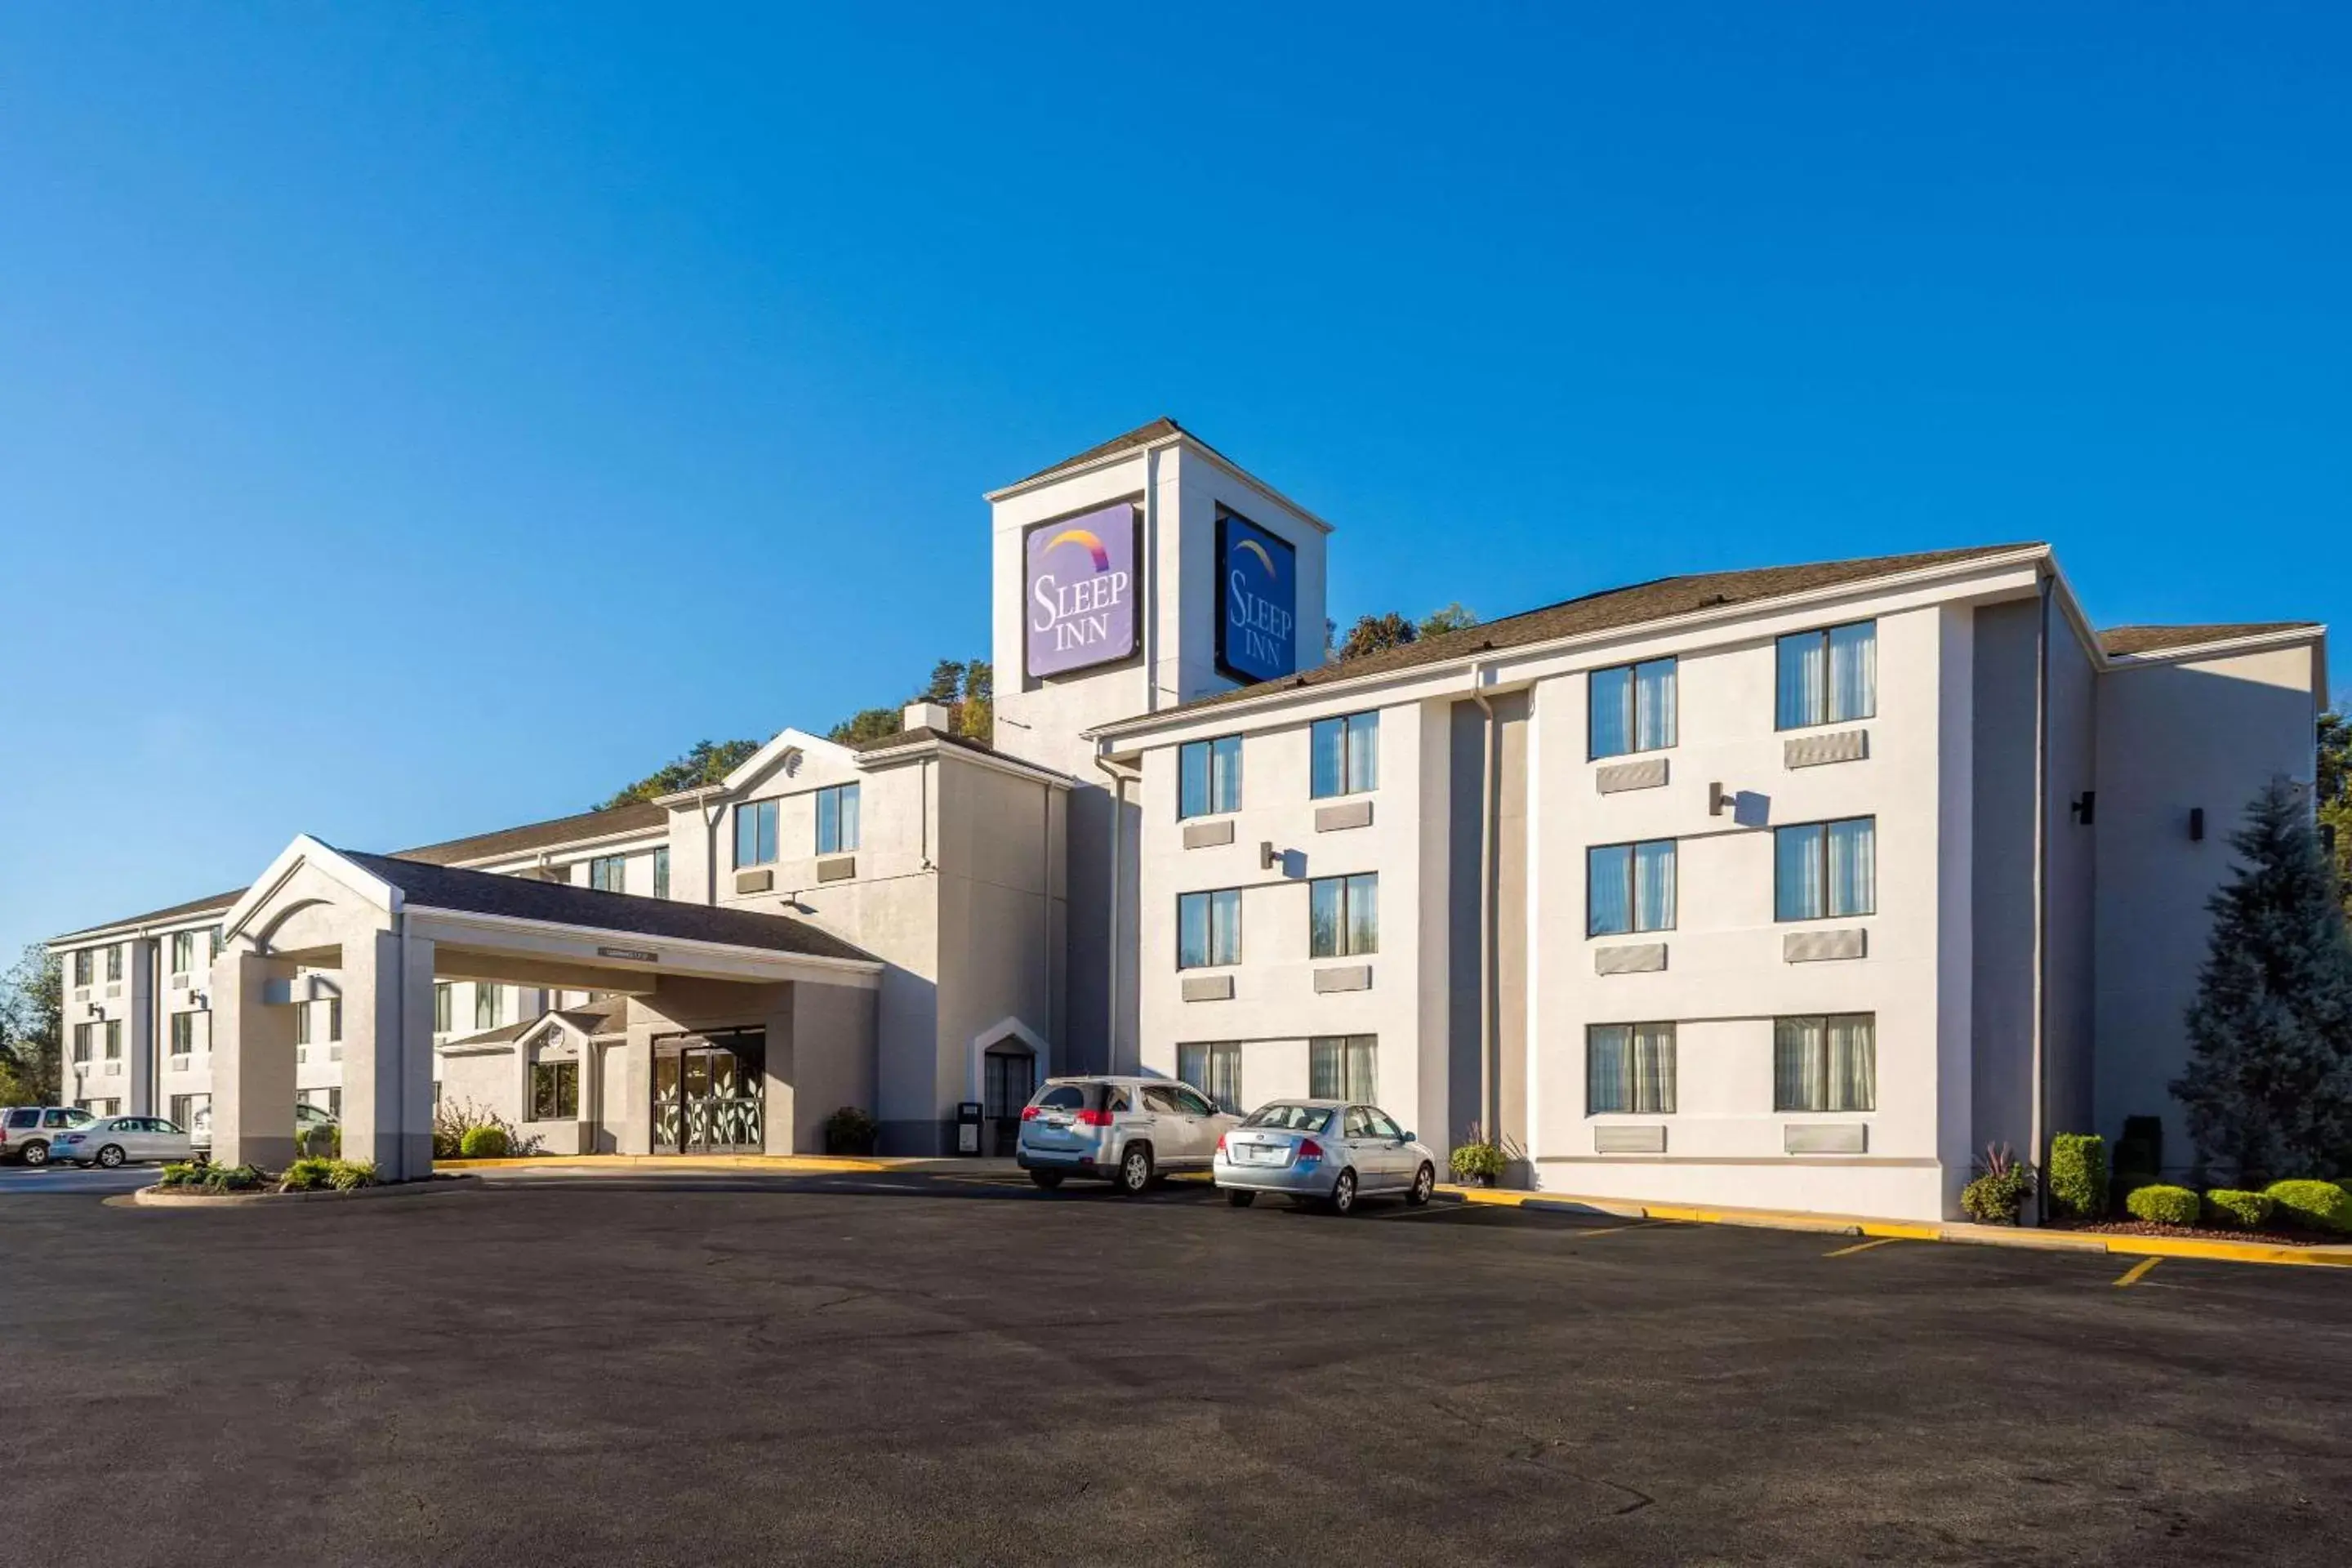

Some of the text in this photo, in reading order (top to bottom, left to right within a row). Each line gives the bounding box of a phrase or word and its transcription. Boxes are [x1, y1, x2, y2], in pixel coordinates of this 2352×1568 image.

[1035, 572, 1127, 632] SLEEP
[1231, 569, 1291, 640] SLEEP
[1054, 613, 1109, 651] INN
[1245, 628, 1280, 668] INN
